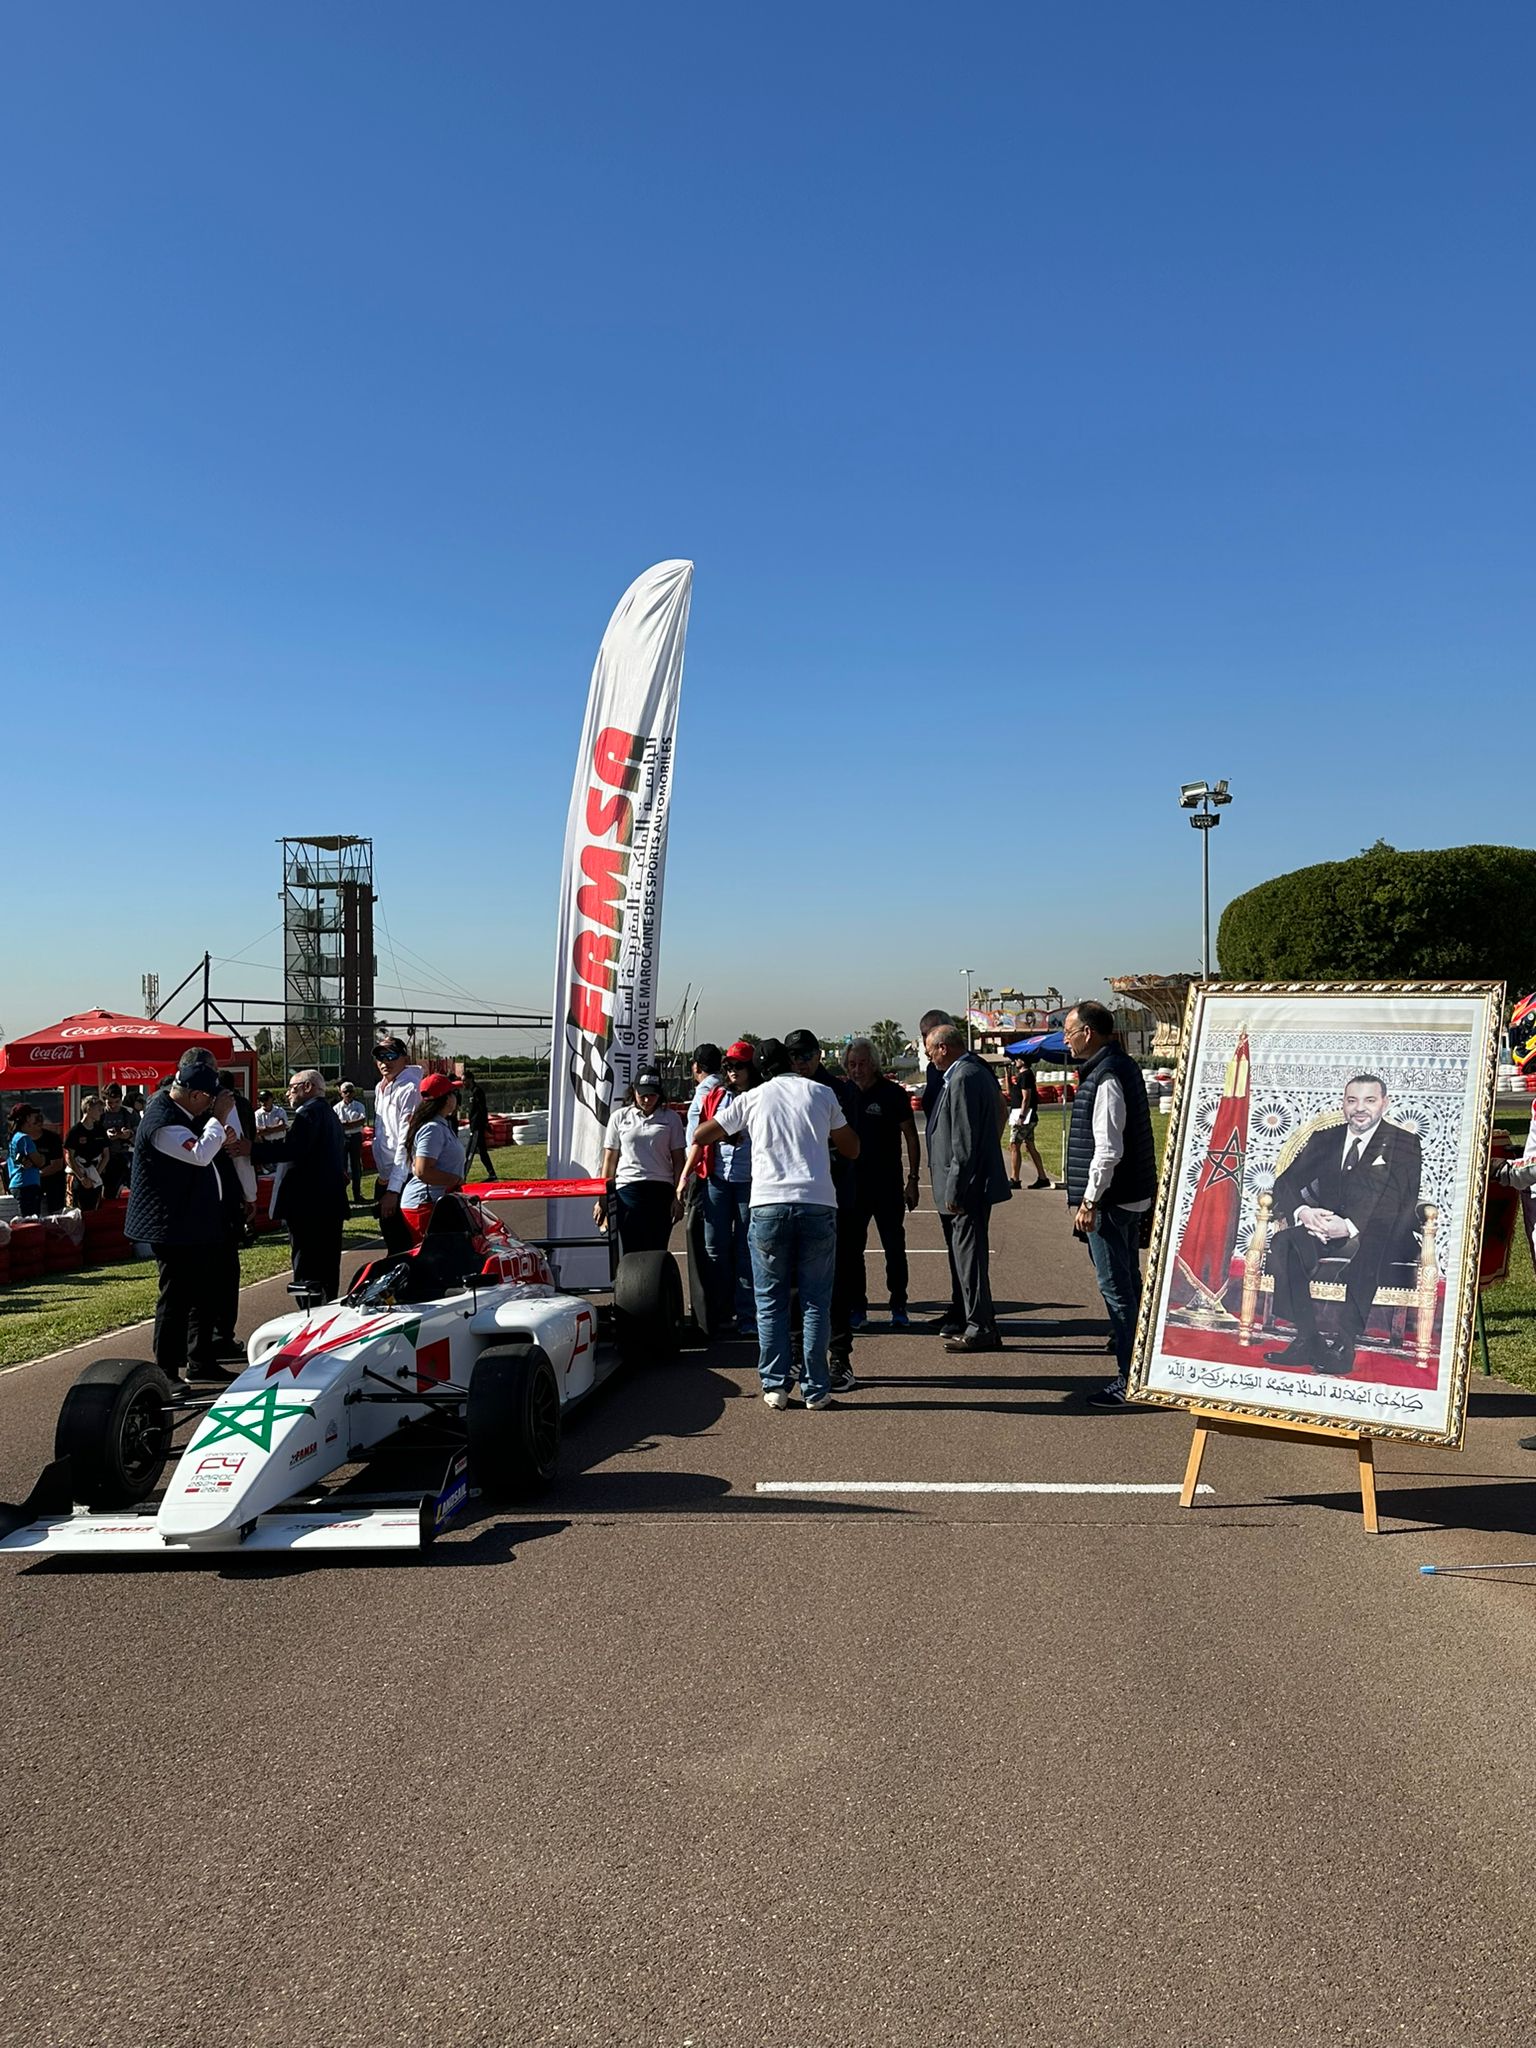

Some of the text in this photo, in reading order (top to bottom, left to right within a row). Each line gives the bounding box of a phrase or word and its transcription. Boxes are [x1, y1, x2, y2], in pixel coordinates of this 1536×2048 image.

[639, 738, 659, 811] الجامعة
[653, 736, 673, 833] AUTOMOBILES
[571, 727, 645, 1040] FRMSA
[630, 819, 650, 890] الملكية
[646, 834, 660, 887] SPORTS
[644, 890, 656, 915] DES
[621, 899, 641, 978] المغربية
[639, 918, 654, 999] MAROCAINE
[615, 985, 637, 1046] لسباق
[638, 1001, 650, 1050] ROYALE
[195, 1457, 246, 1474] F4
